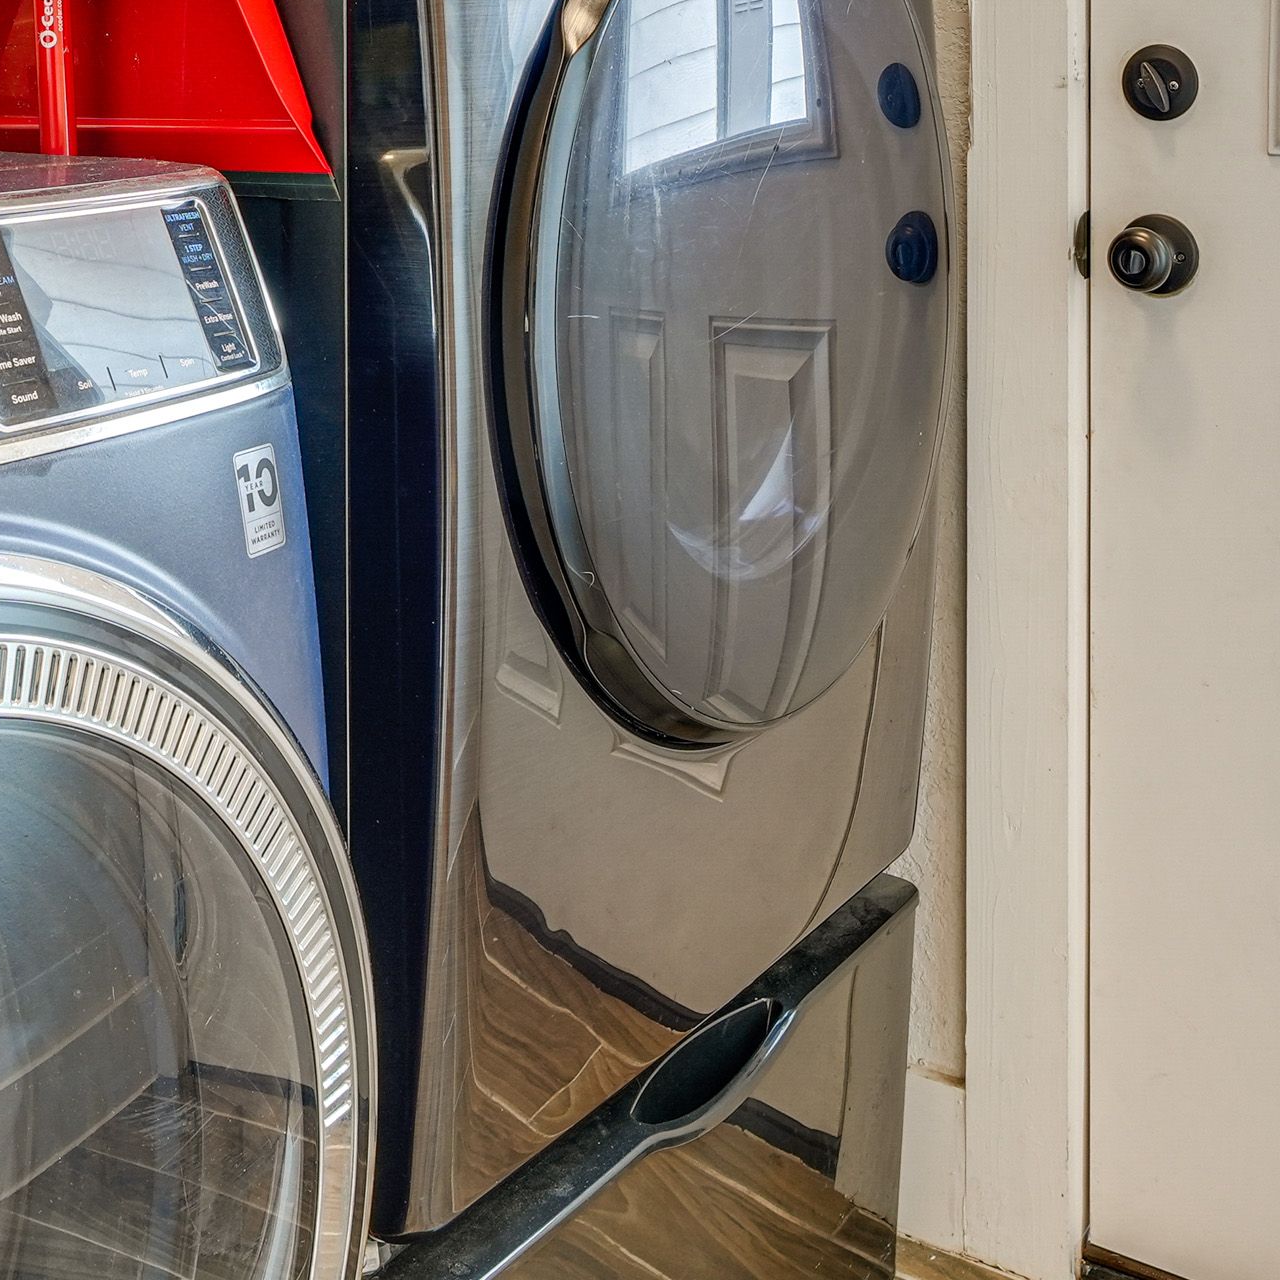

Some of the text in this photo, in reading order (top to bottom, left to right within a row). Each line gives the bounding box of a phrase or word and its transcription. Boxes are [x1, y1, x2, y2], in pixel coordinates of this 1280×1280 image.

[0, 311, 23, 324] Wash
[13, 355, 36, 368] Saver
[11, 391, 39, 405] Sound
[236, 457, 278, 513] 10
[244, 480, 264, 493] YEAR
[254, 520, 276, 534] LIMITED
[251, 530, 281, 546] WARRANTY
